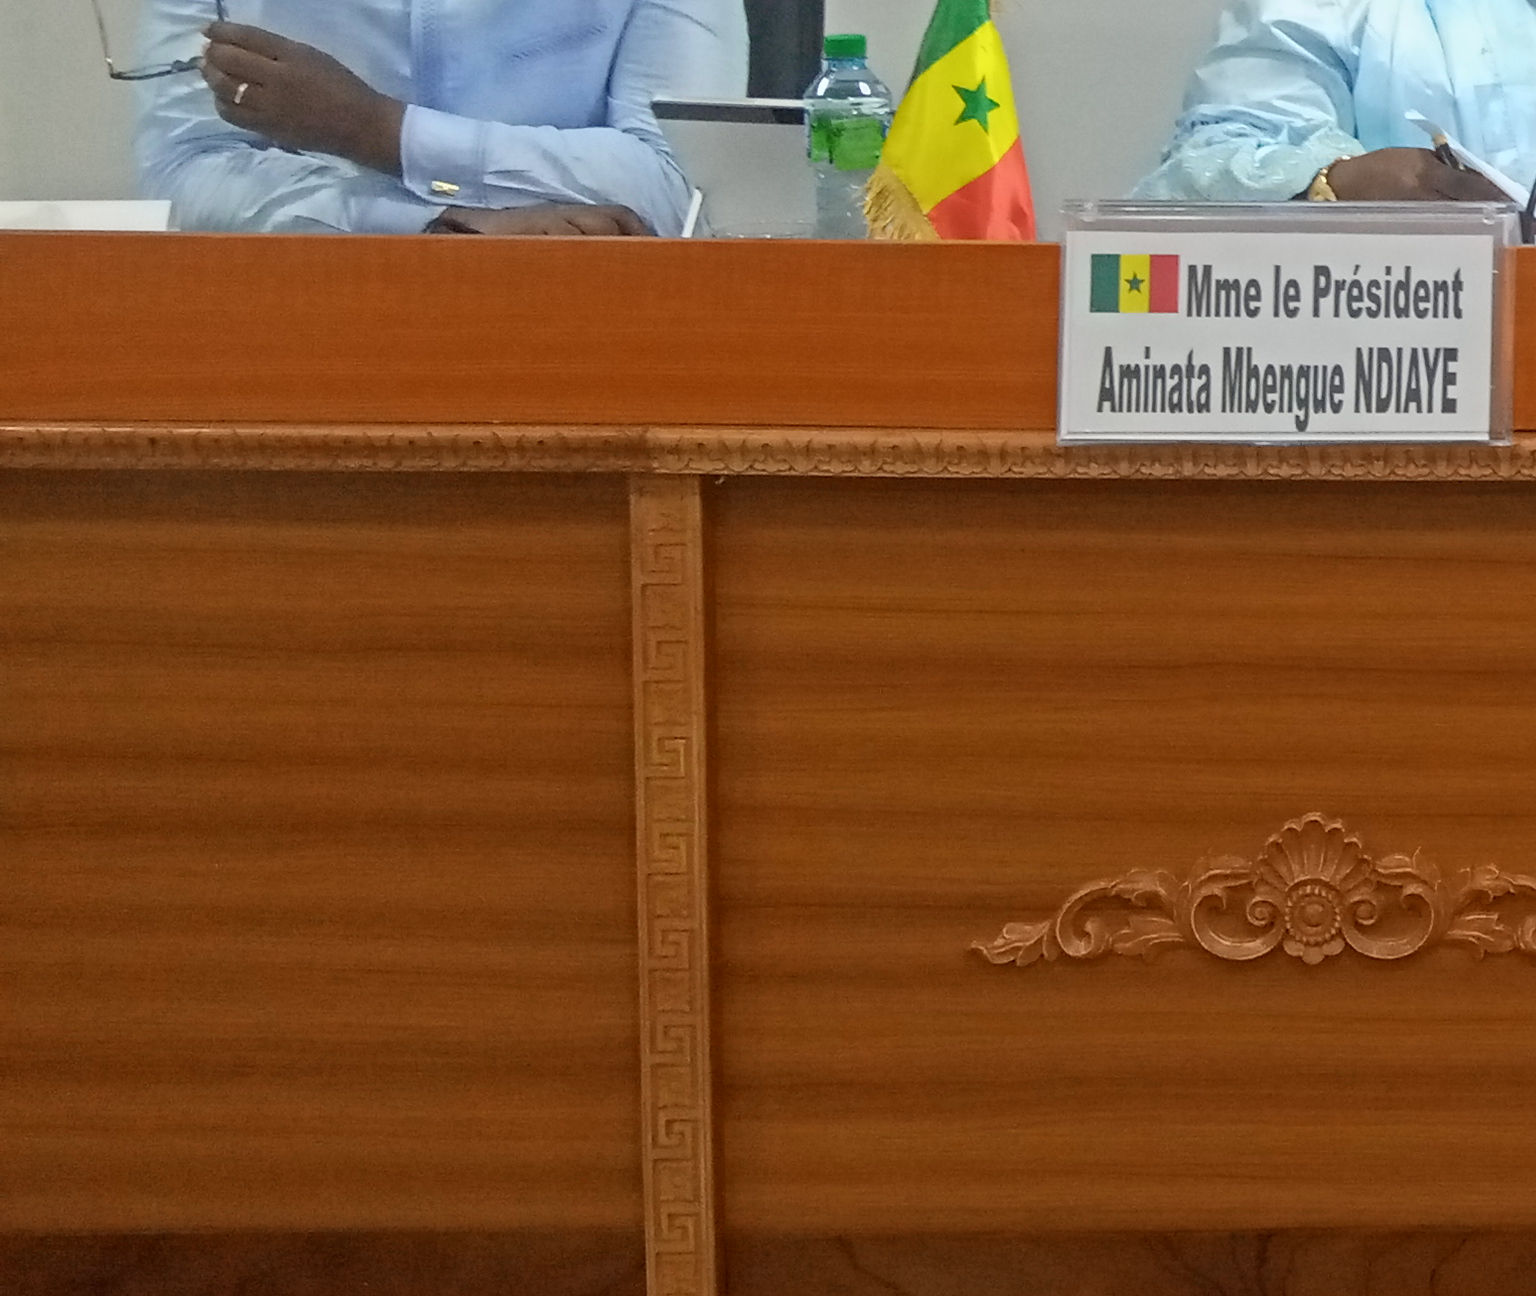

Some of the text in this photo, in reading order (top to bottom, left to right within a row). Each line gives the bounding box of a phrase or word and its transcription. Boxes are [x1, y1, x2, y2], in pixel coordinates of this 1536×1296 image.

[1186, 264, 1464, 320] Mme le Président
[1096, 346, 1459, 432] Aminata Mbengue NDIAYE
